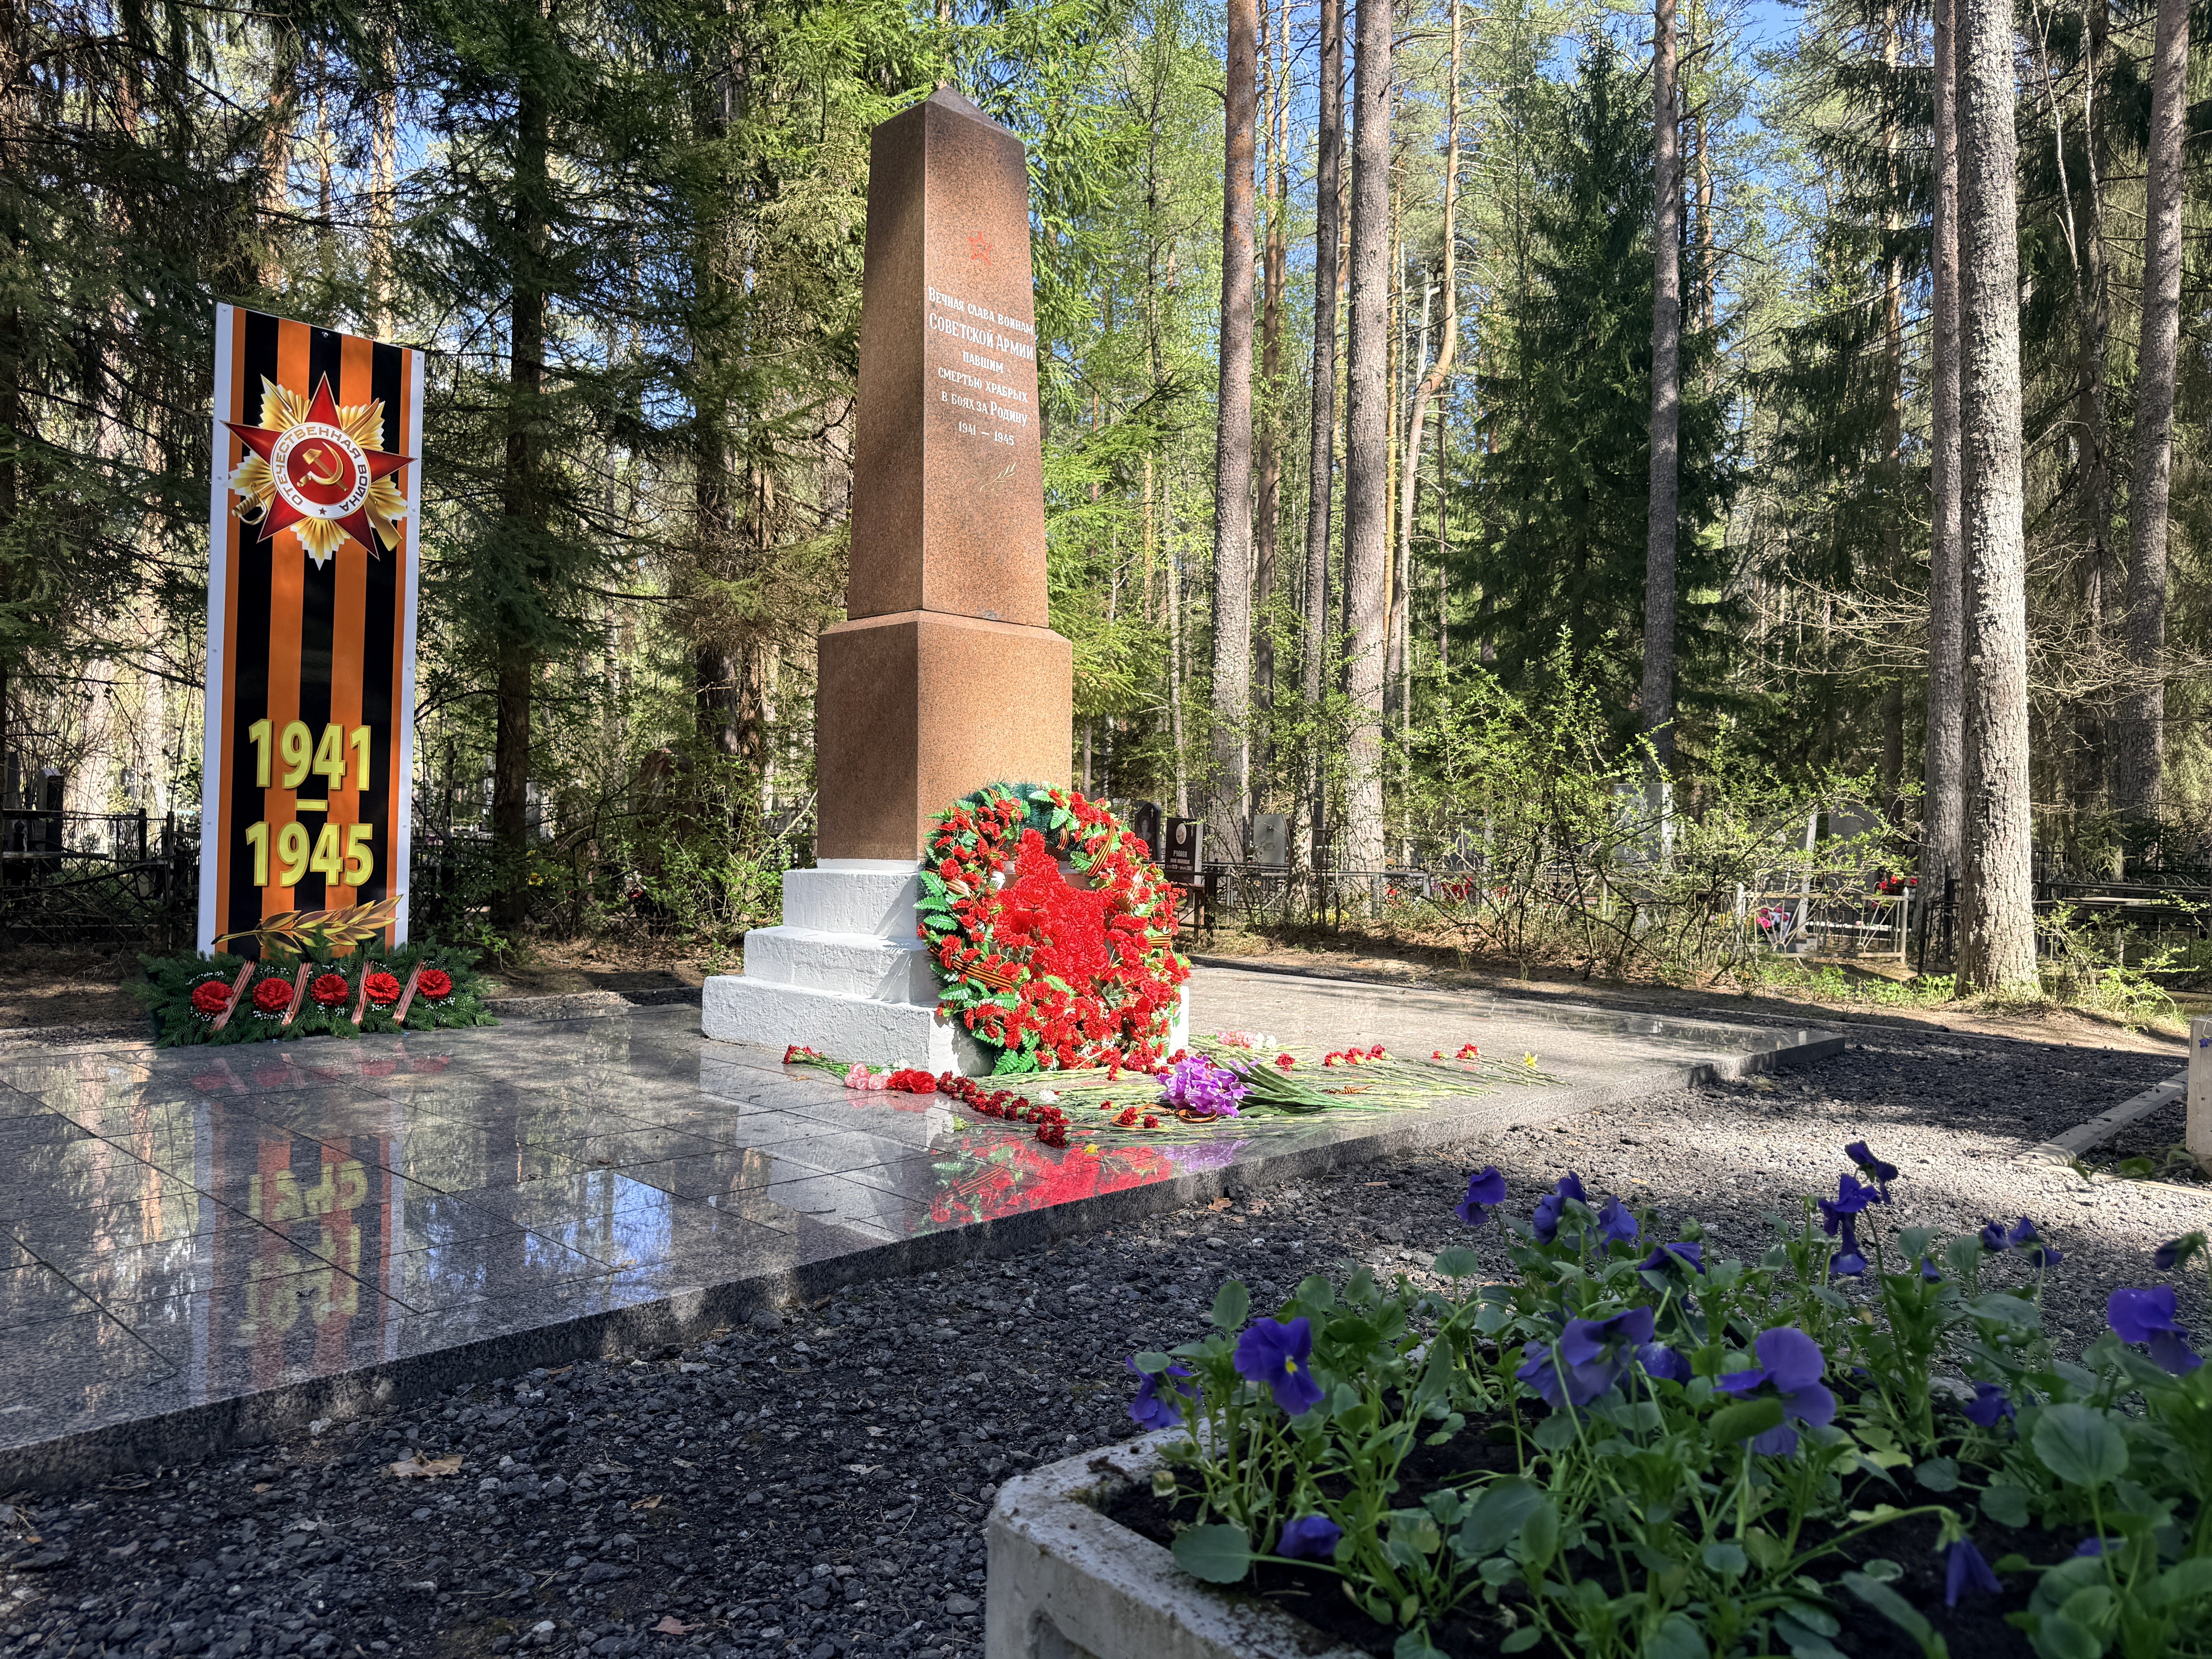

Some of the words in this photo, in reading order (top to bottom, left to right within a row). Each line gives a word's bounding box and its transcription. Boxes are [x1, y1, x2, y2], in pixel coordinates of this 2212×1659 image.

[998, 313, 1034, 335] ВОИНАМ
[962, 350, 1004, 374] ПАВШИМ
[938, 367, 982, 389] СМЕРТЬЮ
[985, 381, 1029, 403] ХРАБРЫХ
[941, 390, 948, 402] В
[951, 393, 975, 410] БОЯХ
[976, 401, 988, 414] ЗА
[958, 421, 976, 436] 1941
[994, 430, 1014, 446] 1945
[276, 426, 361, 507] ОТЕЧЕСТВЕННАЯ
[249, 718, 371, 791] 1941
[246, 821, 373, 887] 1945
